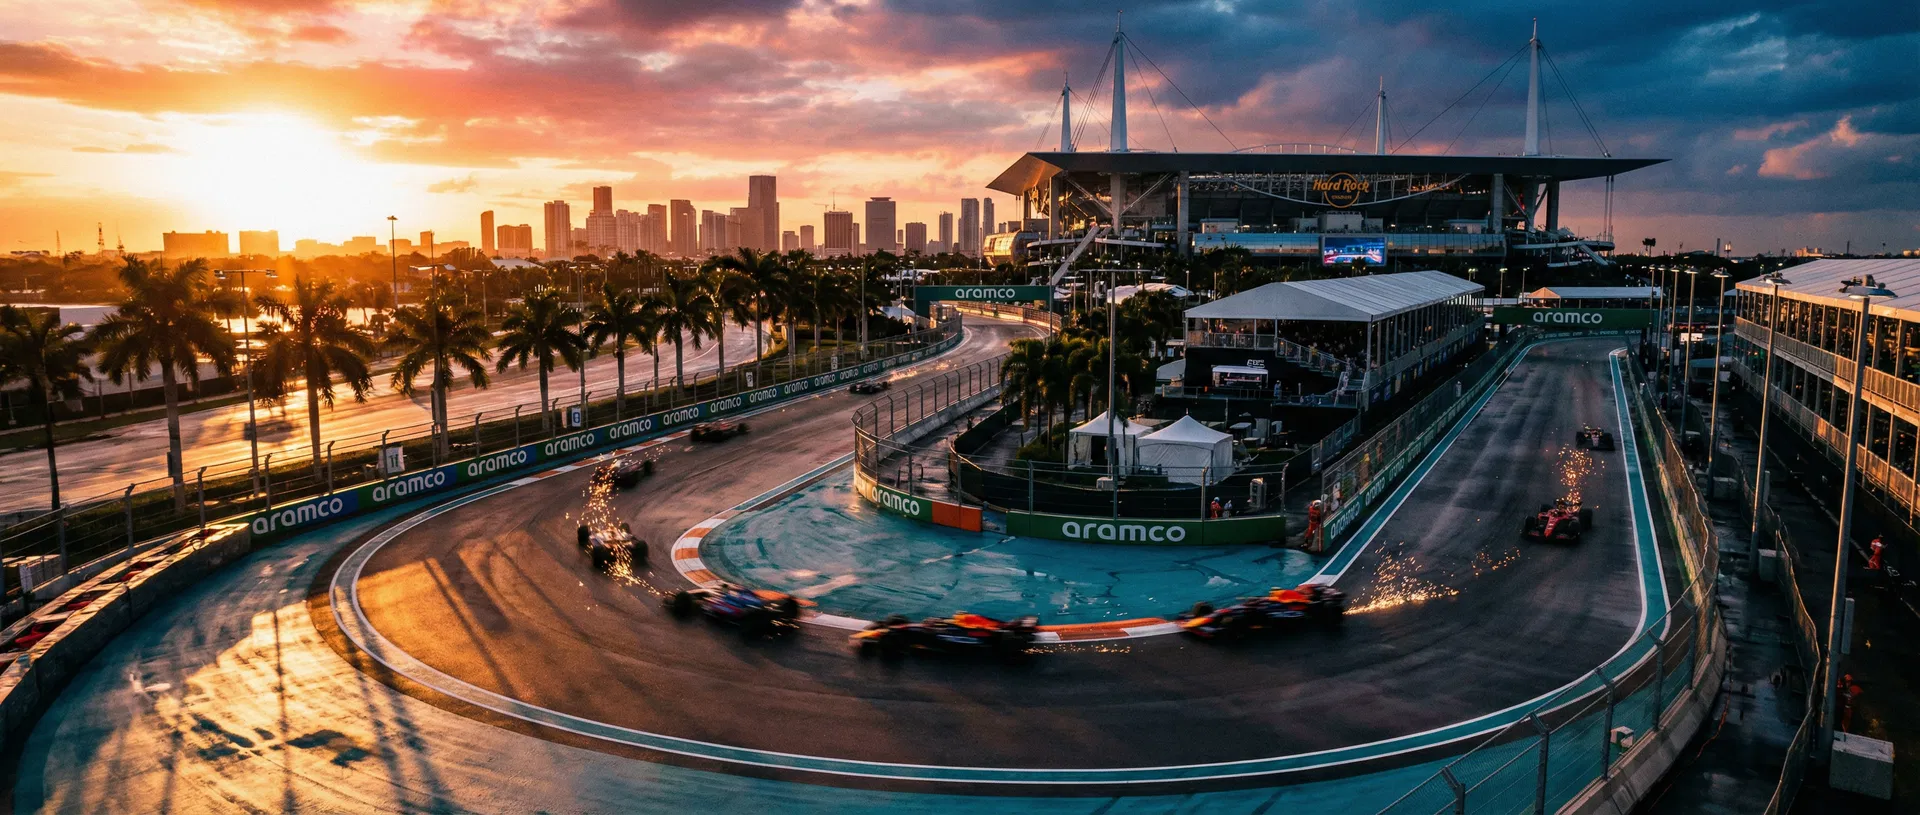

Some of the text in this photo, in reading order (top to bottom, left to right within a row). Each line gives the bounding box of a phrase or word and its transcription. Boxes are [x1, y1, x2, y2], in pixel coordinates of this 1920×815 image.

[1312, 178, 1370, 193] Hard Rock
[955, 288, 1016, 299] aramco
[1533, 312, 1603, 324] aramco
[749, 388, 777, 403] aramco
[784, 380, 809, 394] aramco
[710, 397, 742, 413] aramco
[663, 407, 699, 426] aramco
[609, 419, 652, 439] aramco
[545, 433, 595, 456] aramco
[467, 450, 527, 476] aramco
[372, 471, 445, 502] aramco
[871, 486, 920, 516] aramco
[252, 497, 343, 535] aramco
[1061, 521, 1186, 542] aramco
